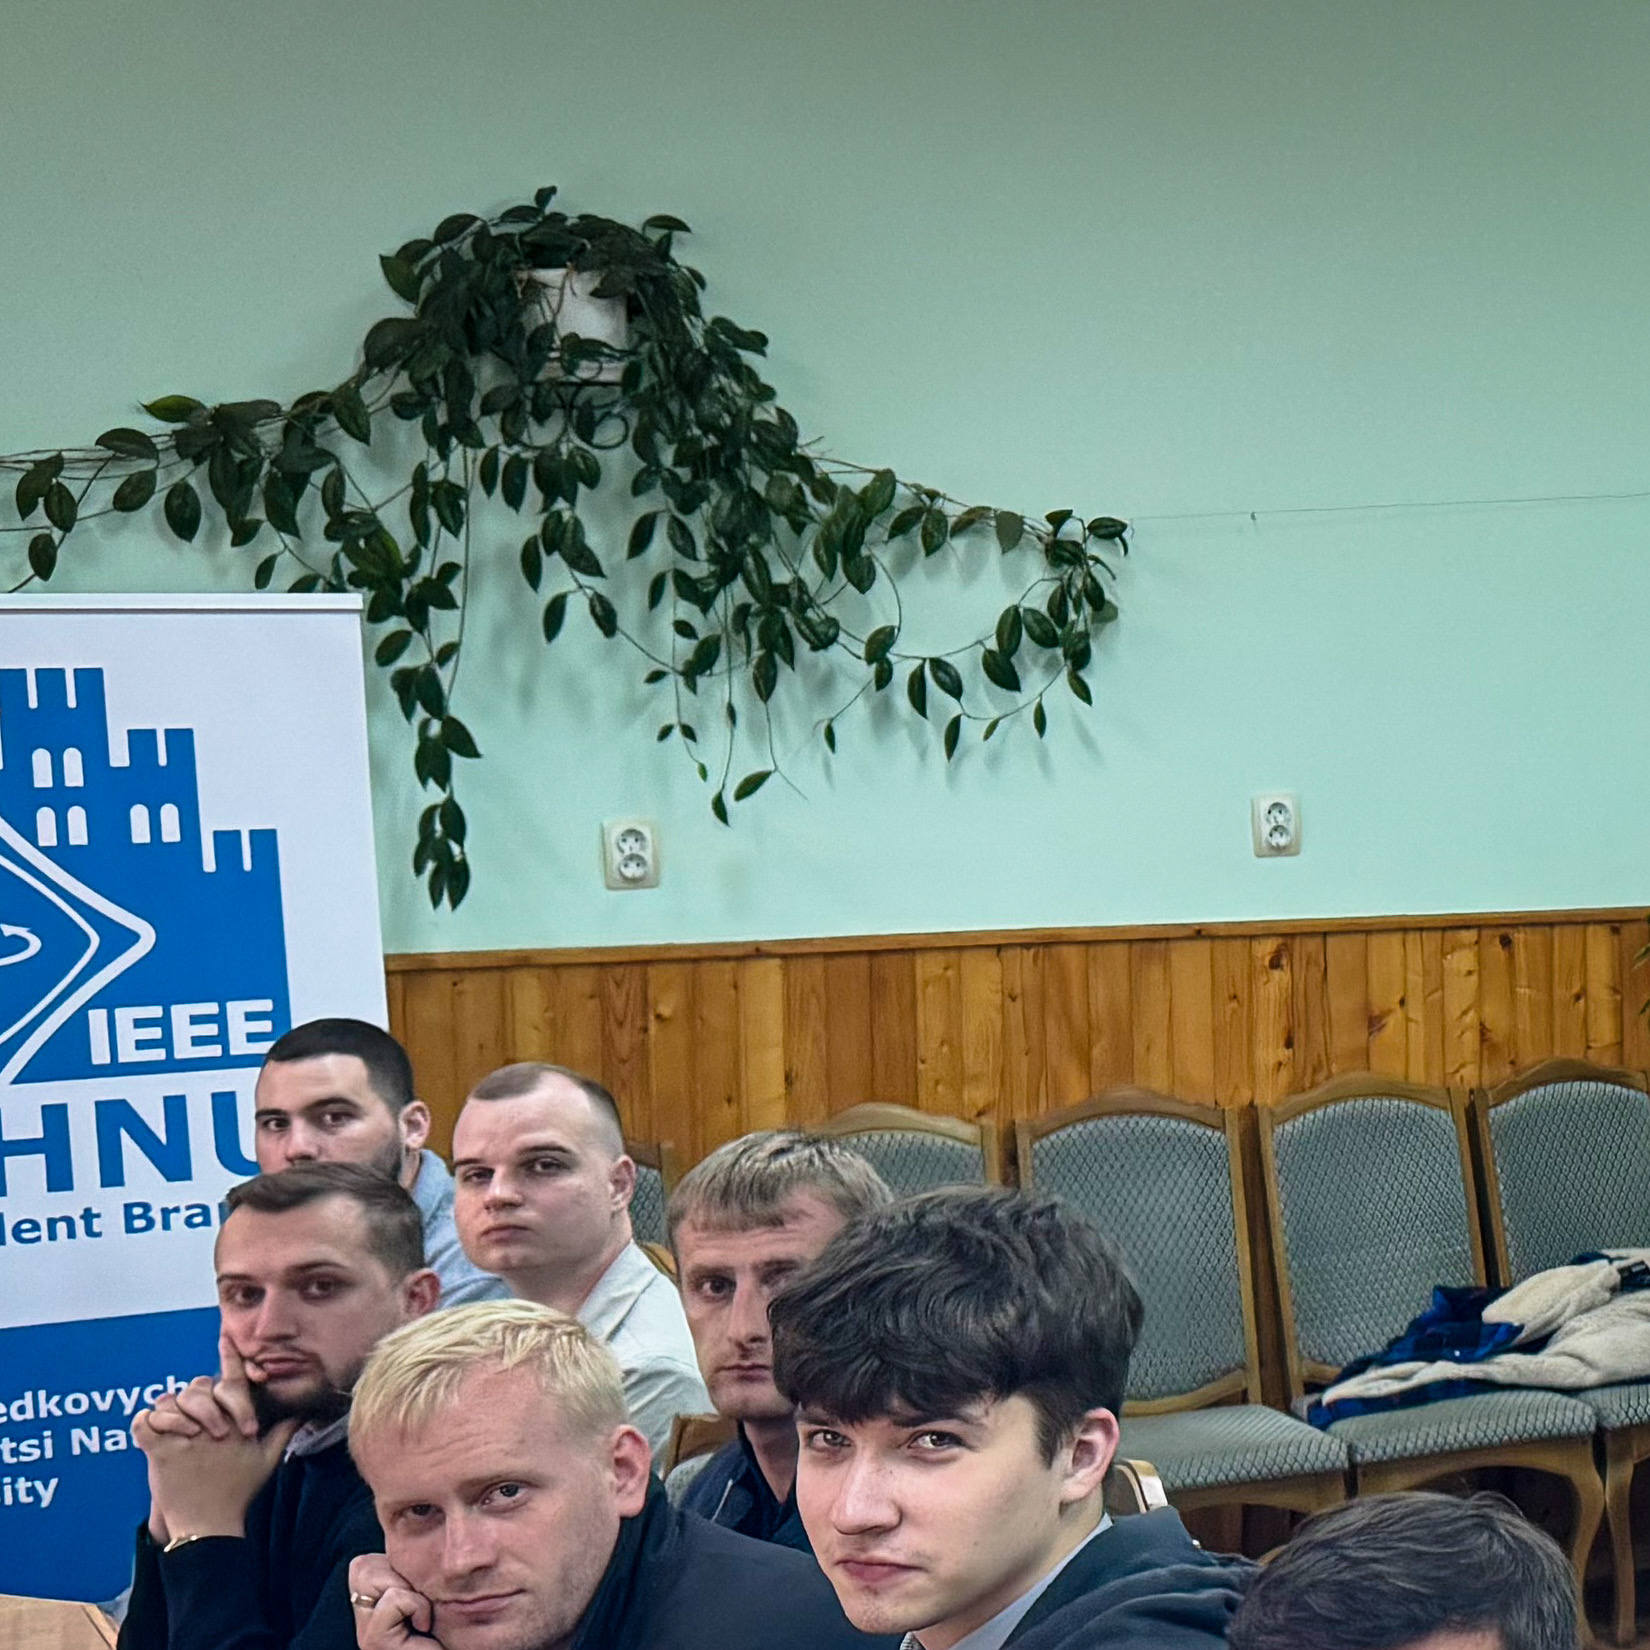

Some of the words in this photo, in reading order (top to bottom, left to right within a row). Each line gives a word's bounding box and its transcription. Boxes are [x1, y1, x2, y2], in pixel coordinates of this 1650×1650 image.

[88, 999, 277, 1065] IEEE
[0, 1206, 103, 1246] ent
[123, 1201, 228, 1234] Bra
[0, 1476, 59, 1508] ity
